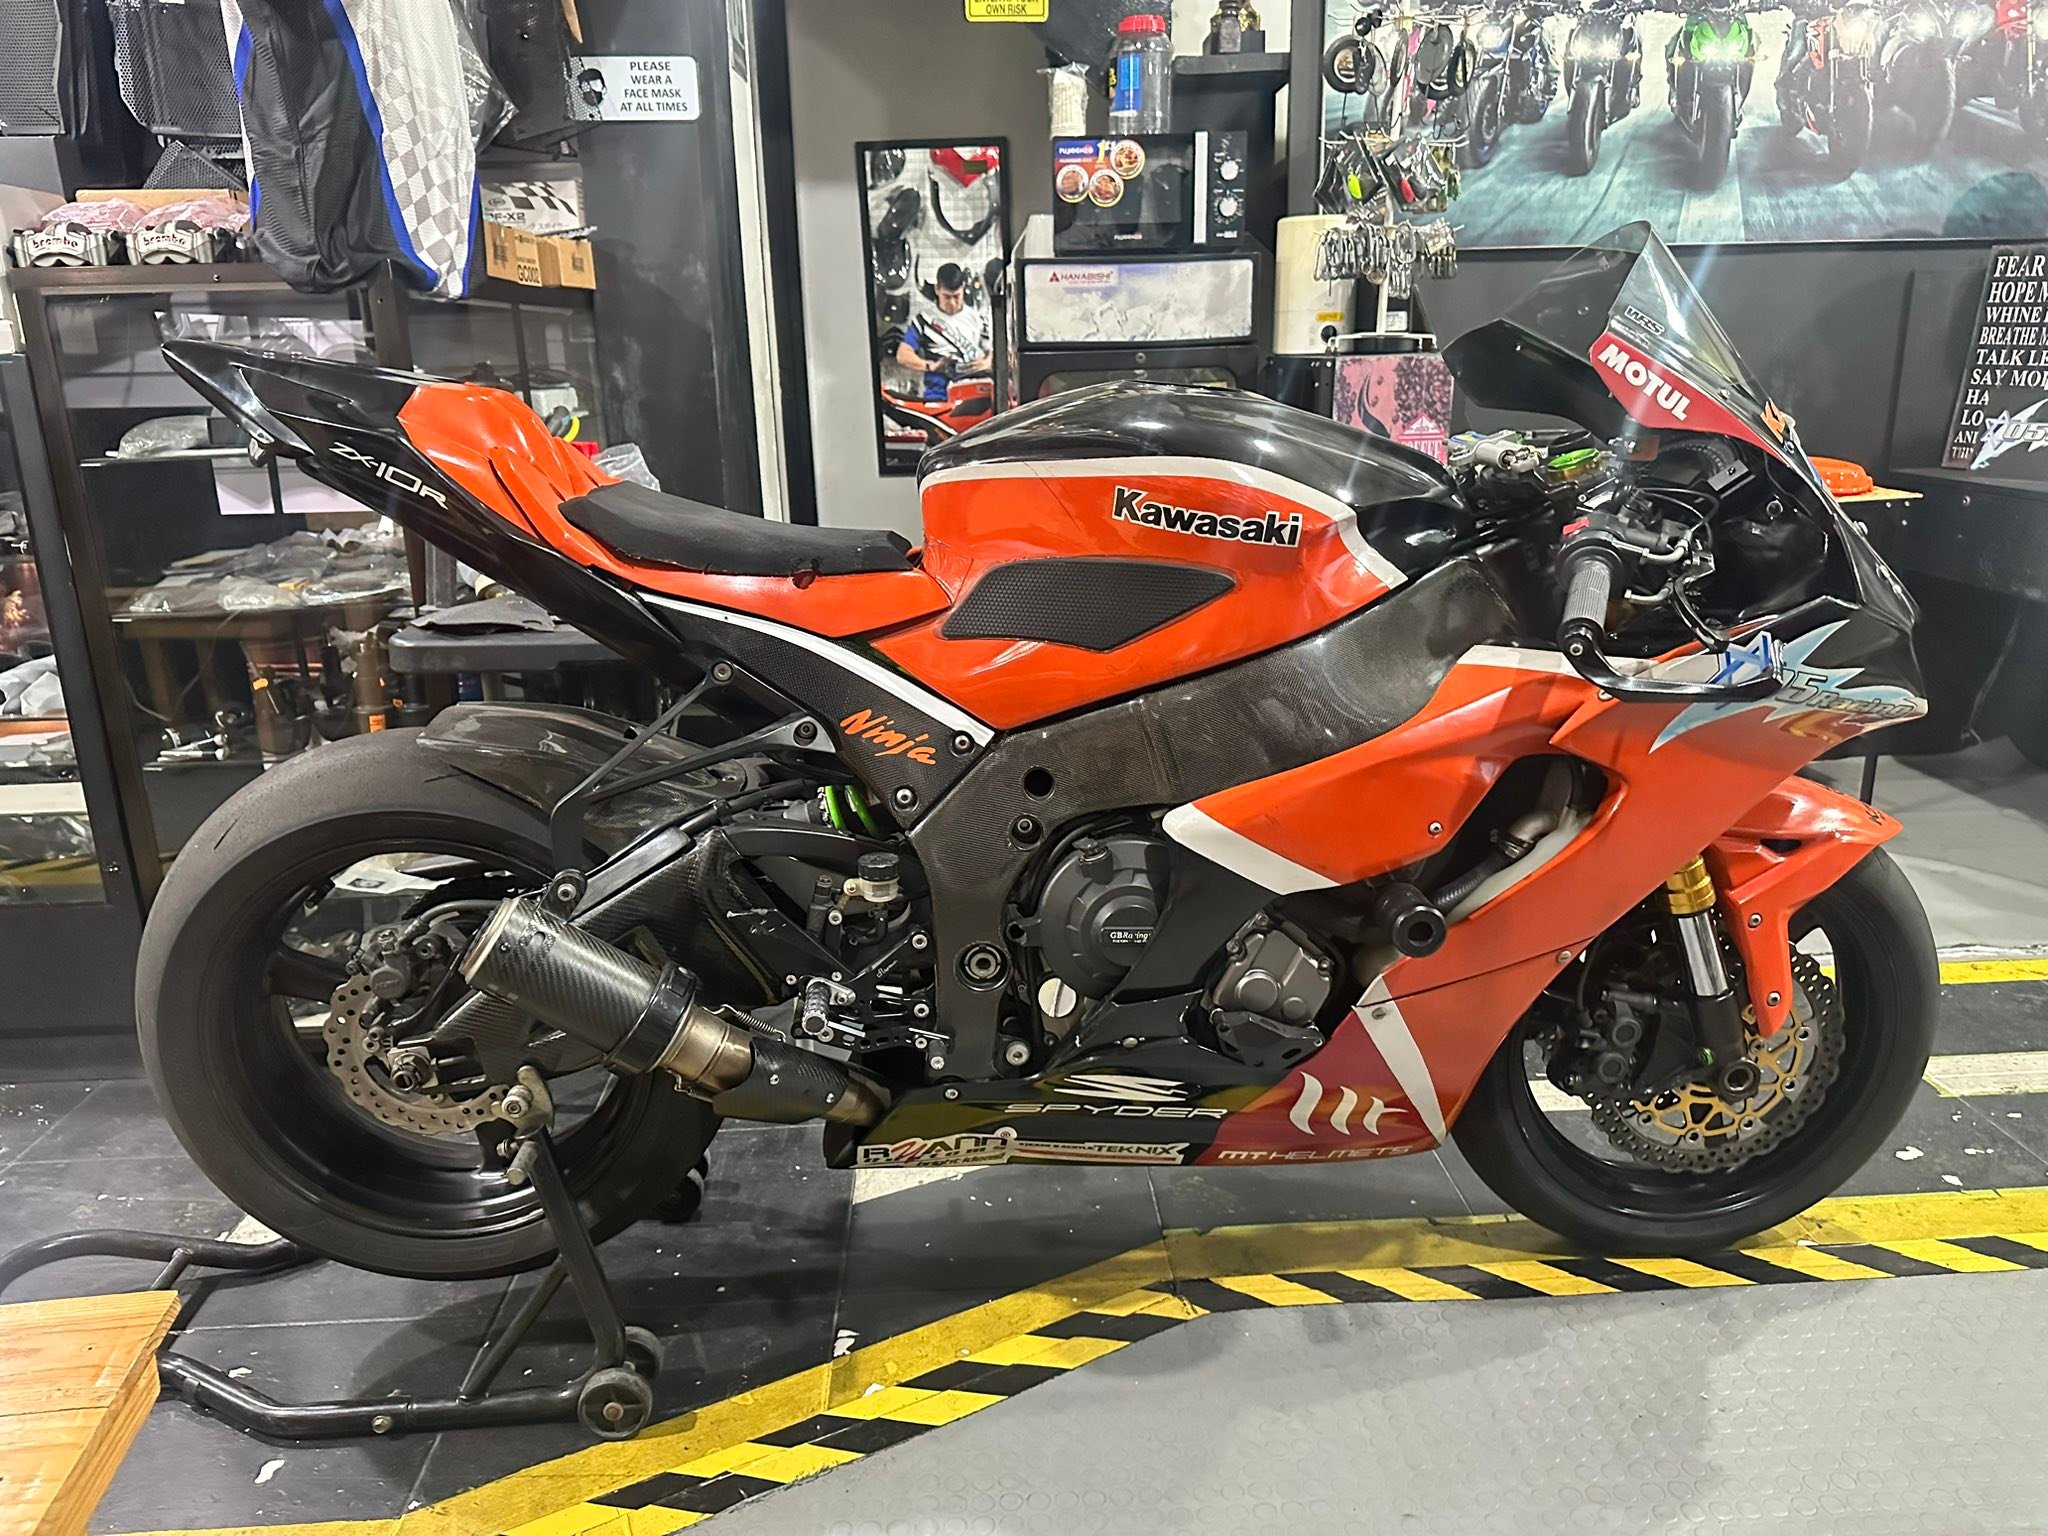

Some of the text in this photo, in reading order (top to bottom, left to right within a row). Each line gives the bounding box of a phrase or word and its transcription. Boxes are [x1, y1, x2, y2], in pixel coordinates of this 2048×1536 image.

[986, 4, 1026, 14] OWN RISK
[630, 61, 671, 71] PLEASE
[631, 75, 672, 85] WEAR A
[624, 89, 681, 98] FACE MASK
[620, 102, 687, 112] AT ALL TIMES
[32, 235, 78, 247] brembo
[143, 234, 186, 246] brembo
[1994, 255, 2046, 277] FEAR
[1988, 281, 2037, 303] HOPE
[1986, 307, 2042, 323] WHINE
[1979, 326, 2038, 345] BREATHE
[1976, 348, 2025, 366] TALK
[1598, 343, 1691, 421] MOTUL
[1970, 368, 2008, 386] SAY
[329, 441, 449, 510] ZX-10R
[1112, 485, 1303, 548] Kawasaki
[840, 709, 936, 765] Ninja
[1110, 931, 1149, 942] GBRaing
[1004, 1104, 1228, 1119] SPYDER
[1094, 1145, 1178, 1155] TEKNIX
[1269, 1146, 1413, 1160] HELMETS
